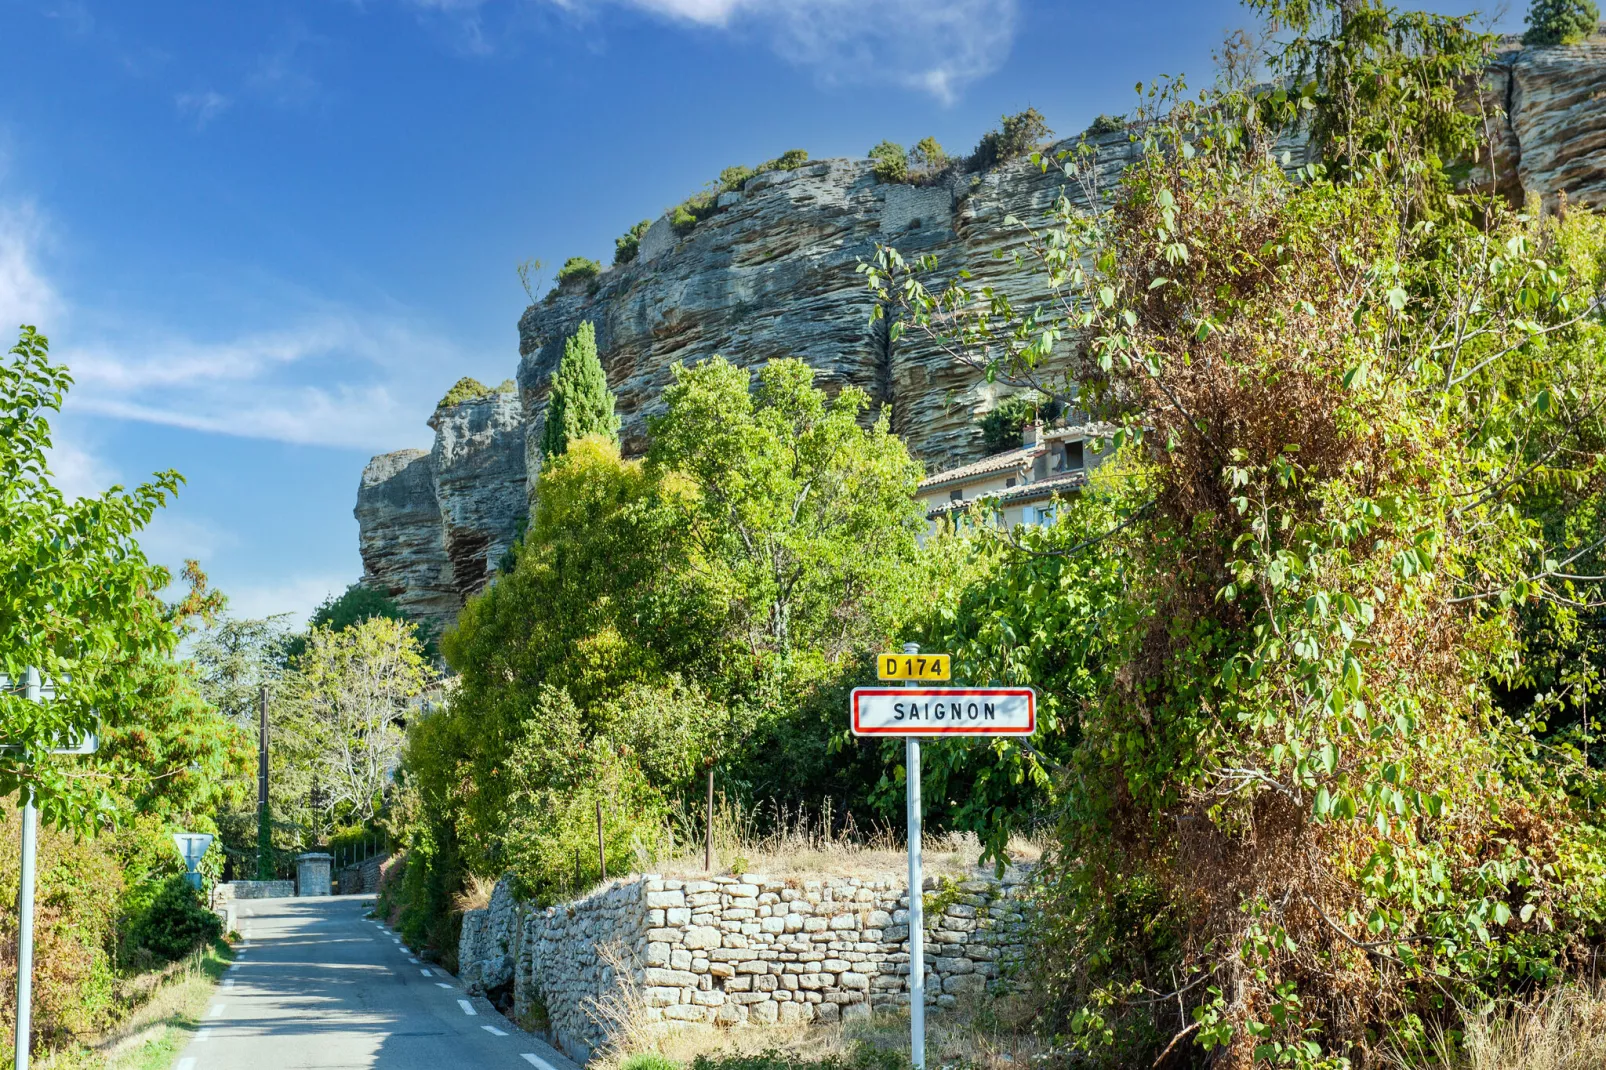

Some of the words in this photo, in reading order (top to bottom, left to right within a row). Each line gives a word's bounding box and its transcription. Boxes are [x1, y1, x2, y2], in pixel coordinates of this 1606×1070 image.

[886, 658, 897, 675] D
[905, 658, 942, 676] 174
[894, 703, 996, 720] SAIGNON
